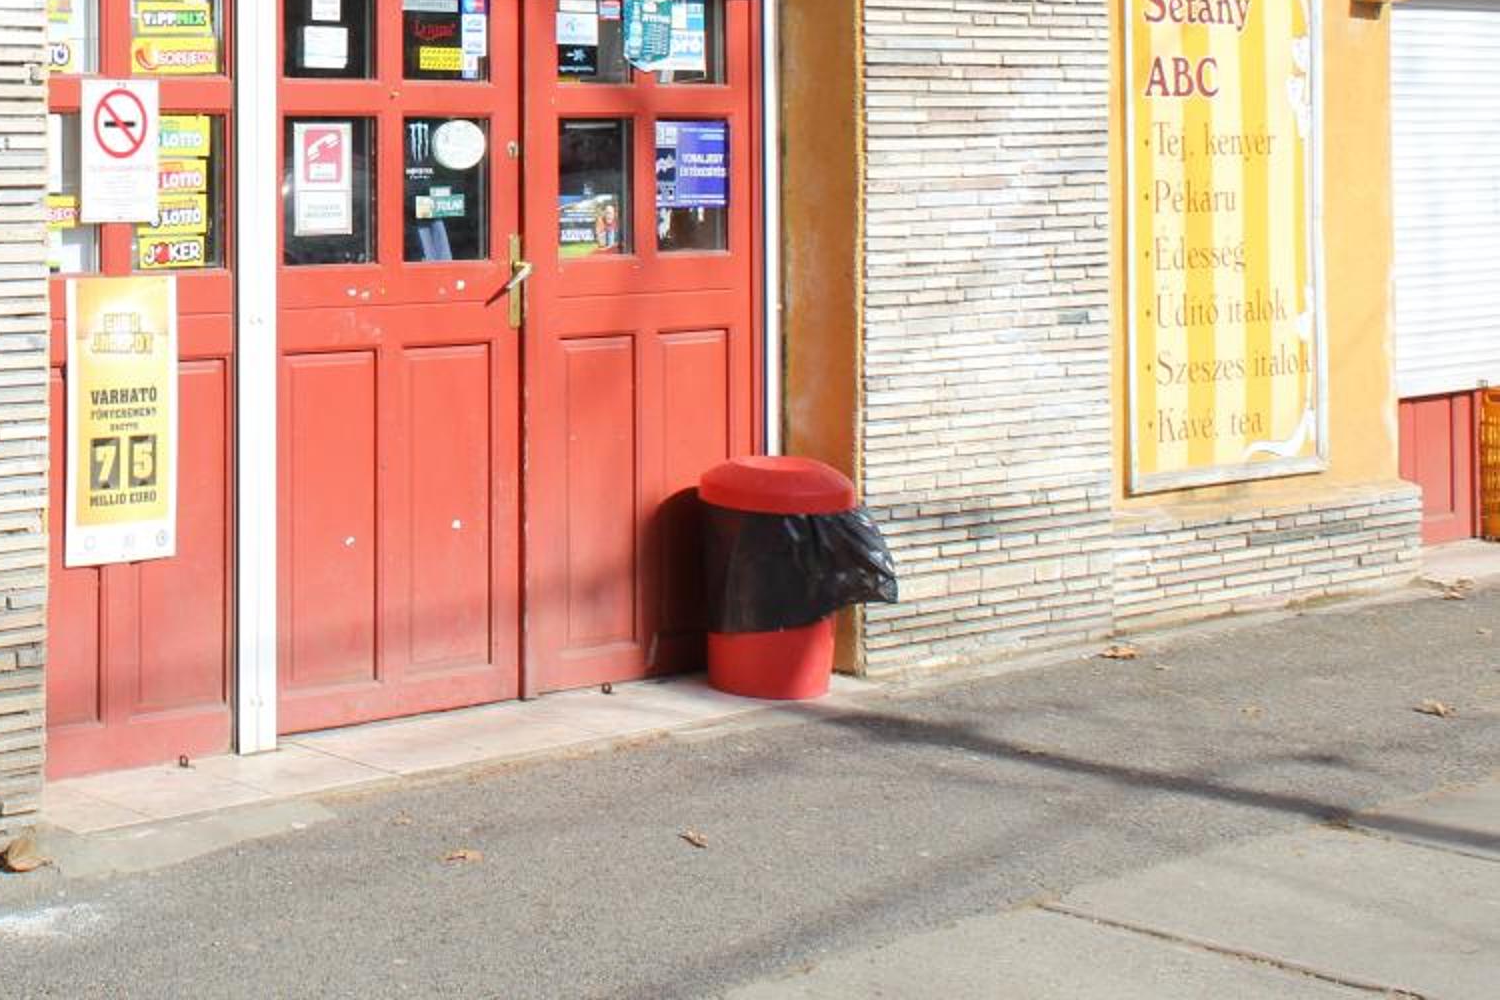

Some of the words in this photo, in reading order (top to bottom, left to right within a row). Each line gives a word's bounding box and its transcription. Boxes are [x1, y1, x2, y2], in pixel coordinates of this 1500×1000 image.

[1145, 56, 1220, 98] ABC
[1204, 121, 1276, 163] kenyér
[1155, 179, 1236, 213] Pékáru
[1155, 225, 1248, 272] Édesség
[1228, 287, 1287, 323] italok
[1155, 351, 1245, 386] Szeszes
[1230, 411, 1263, 436] tea
